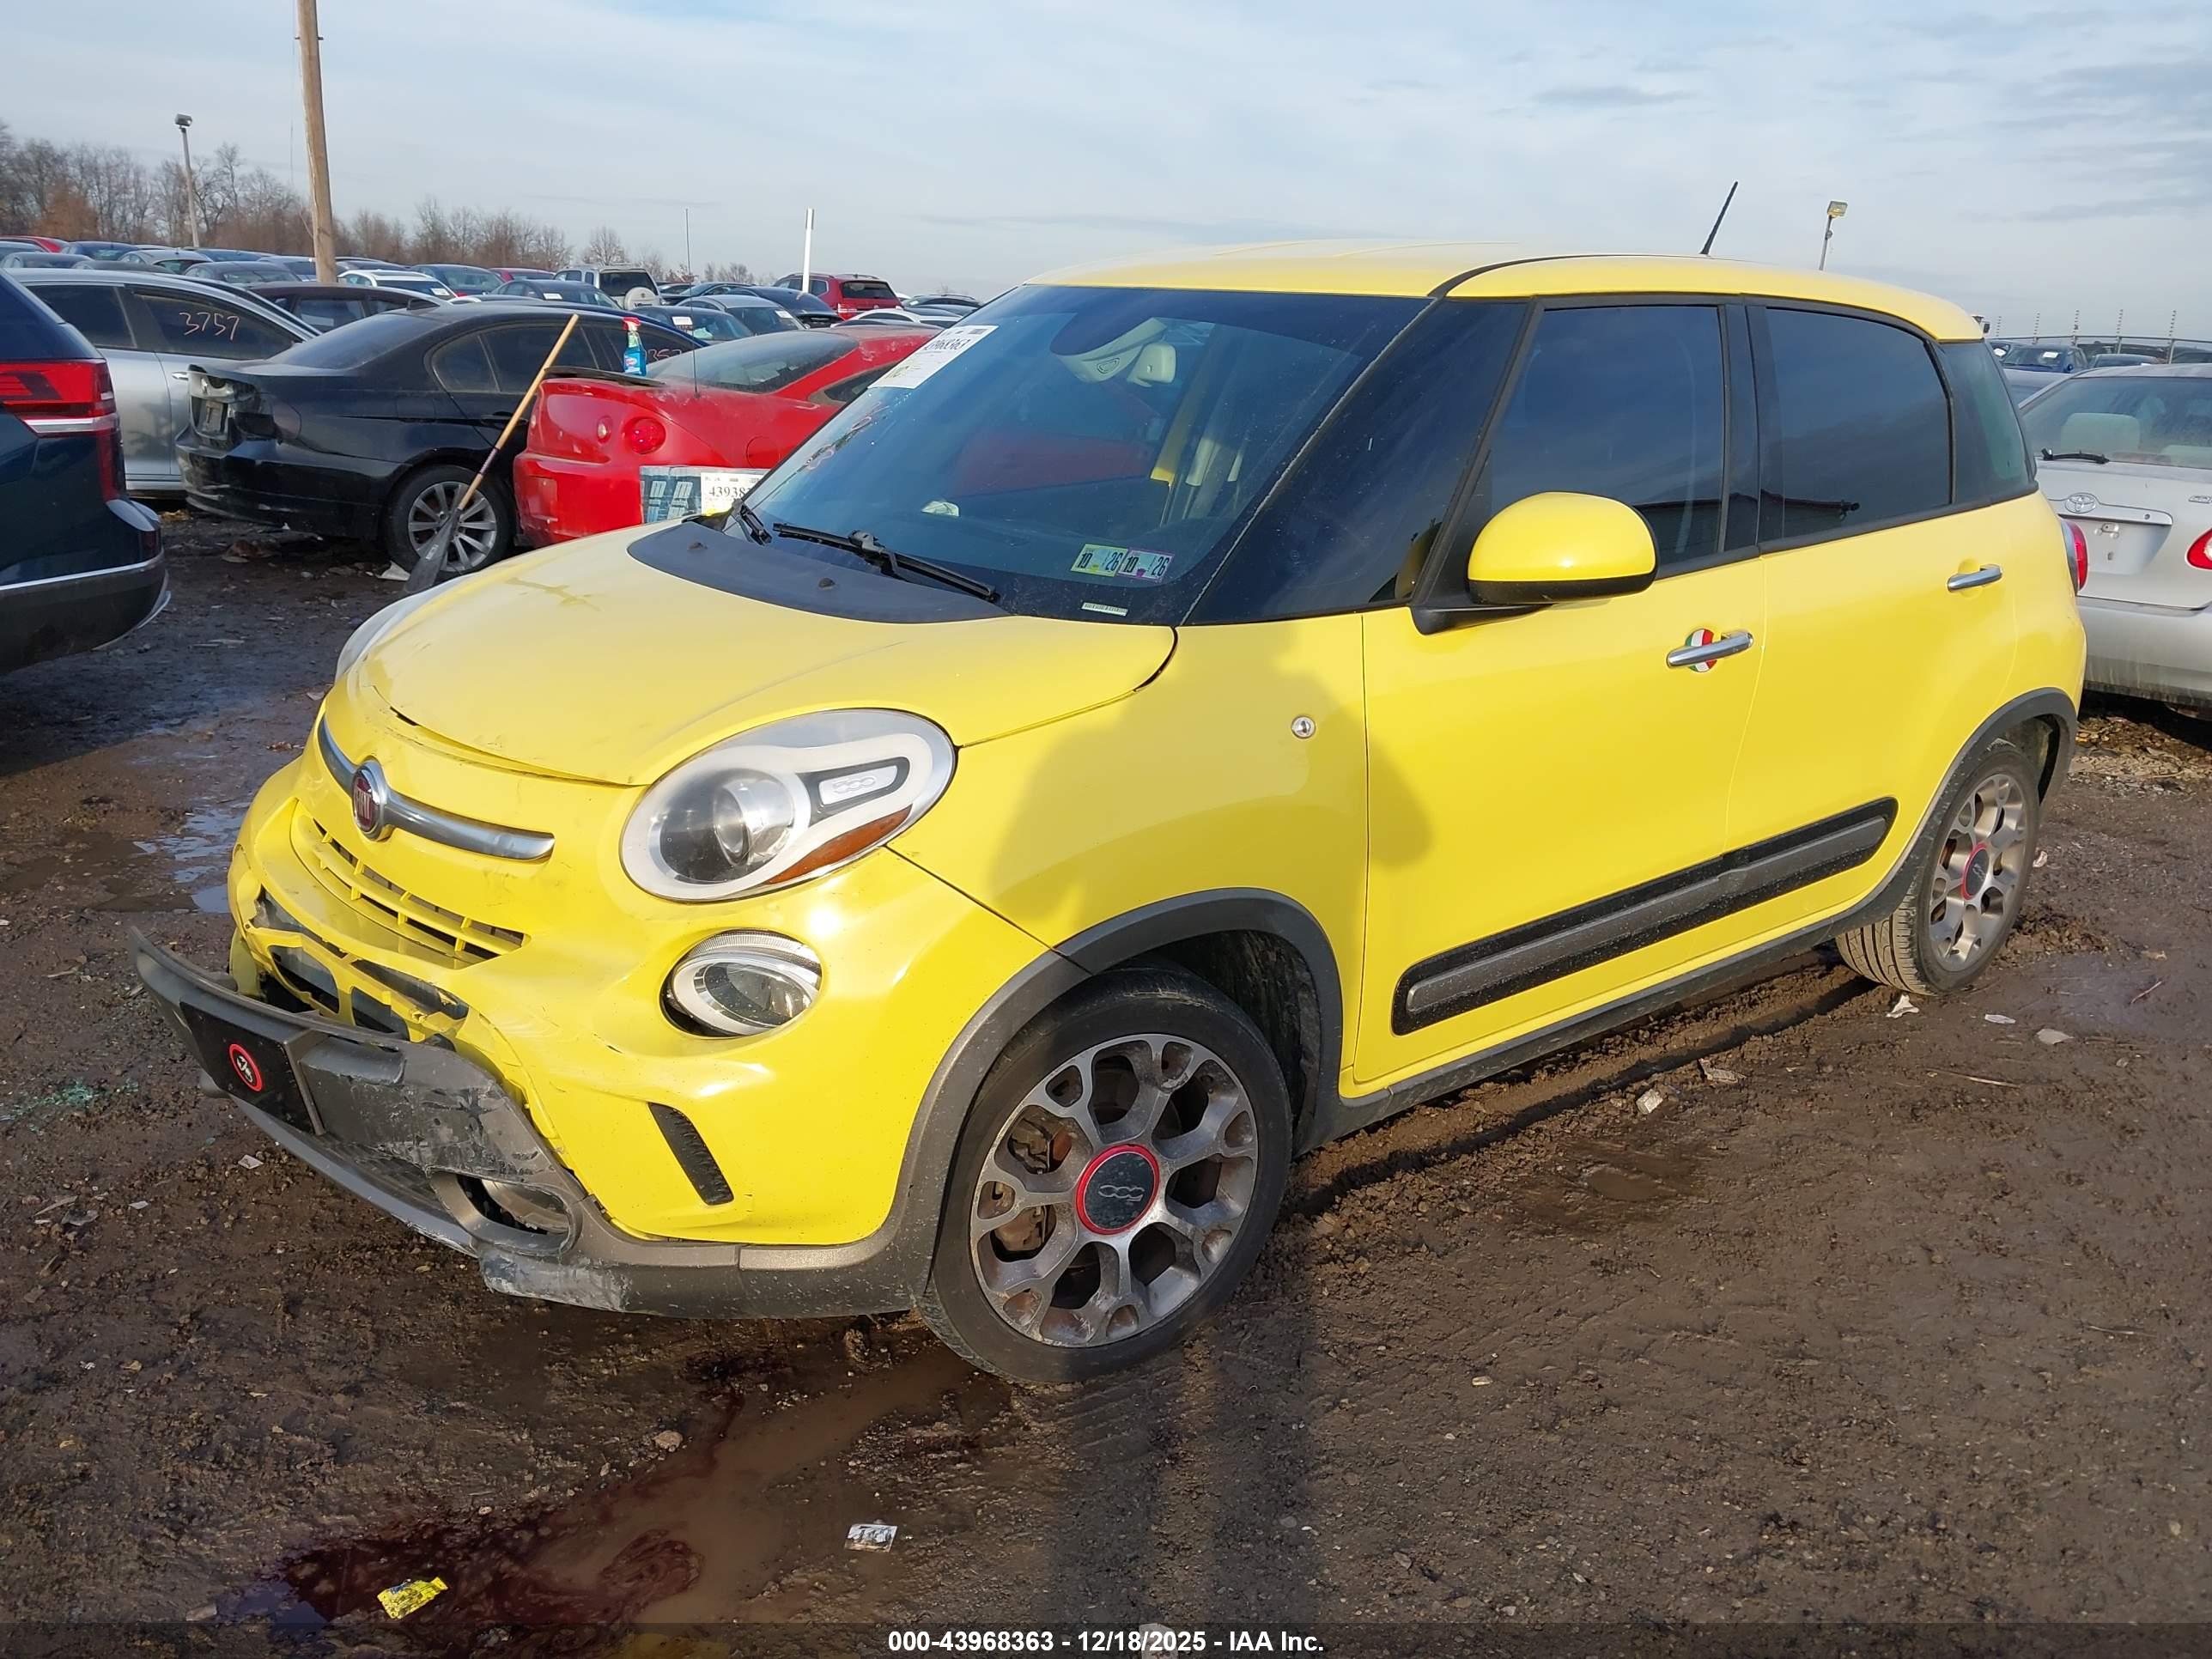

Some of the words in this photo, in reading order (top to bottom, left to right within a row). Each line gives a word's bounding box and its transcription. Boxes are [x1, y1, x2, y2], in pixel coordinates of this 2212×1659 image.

[179, 312, 240, 341] 3757
[1078, 552, 1093, 569] 10
[1104, 551, 1123, 572] 26
[1123, 556, 1139, 574] 10
[1151, 556, 1170, 577] 26
